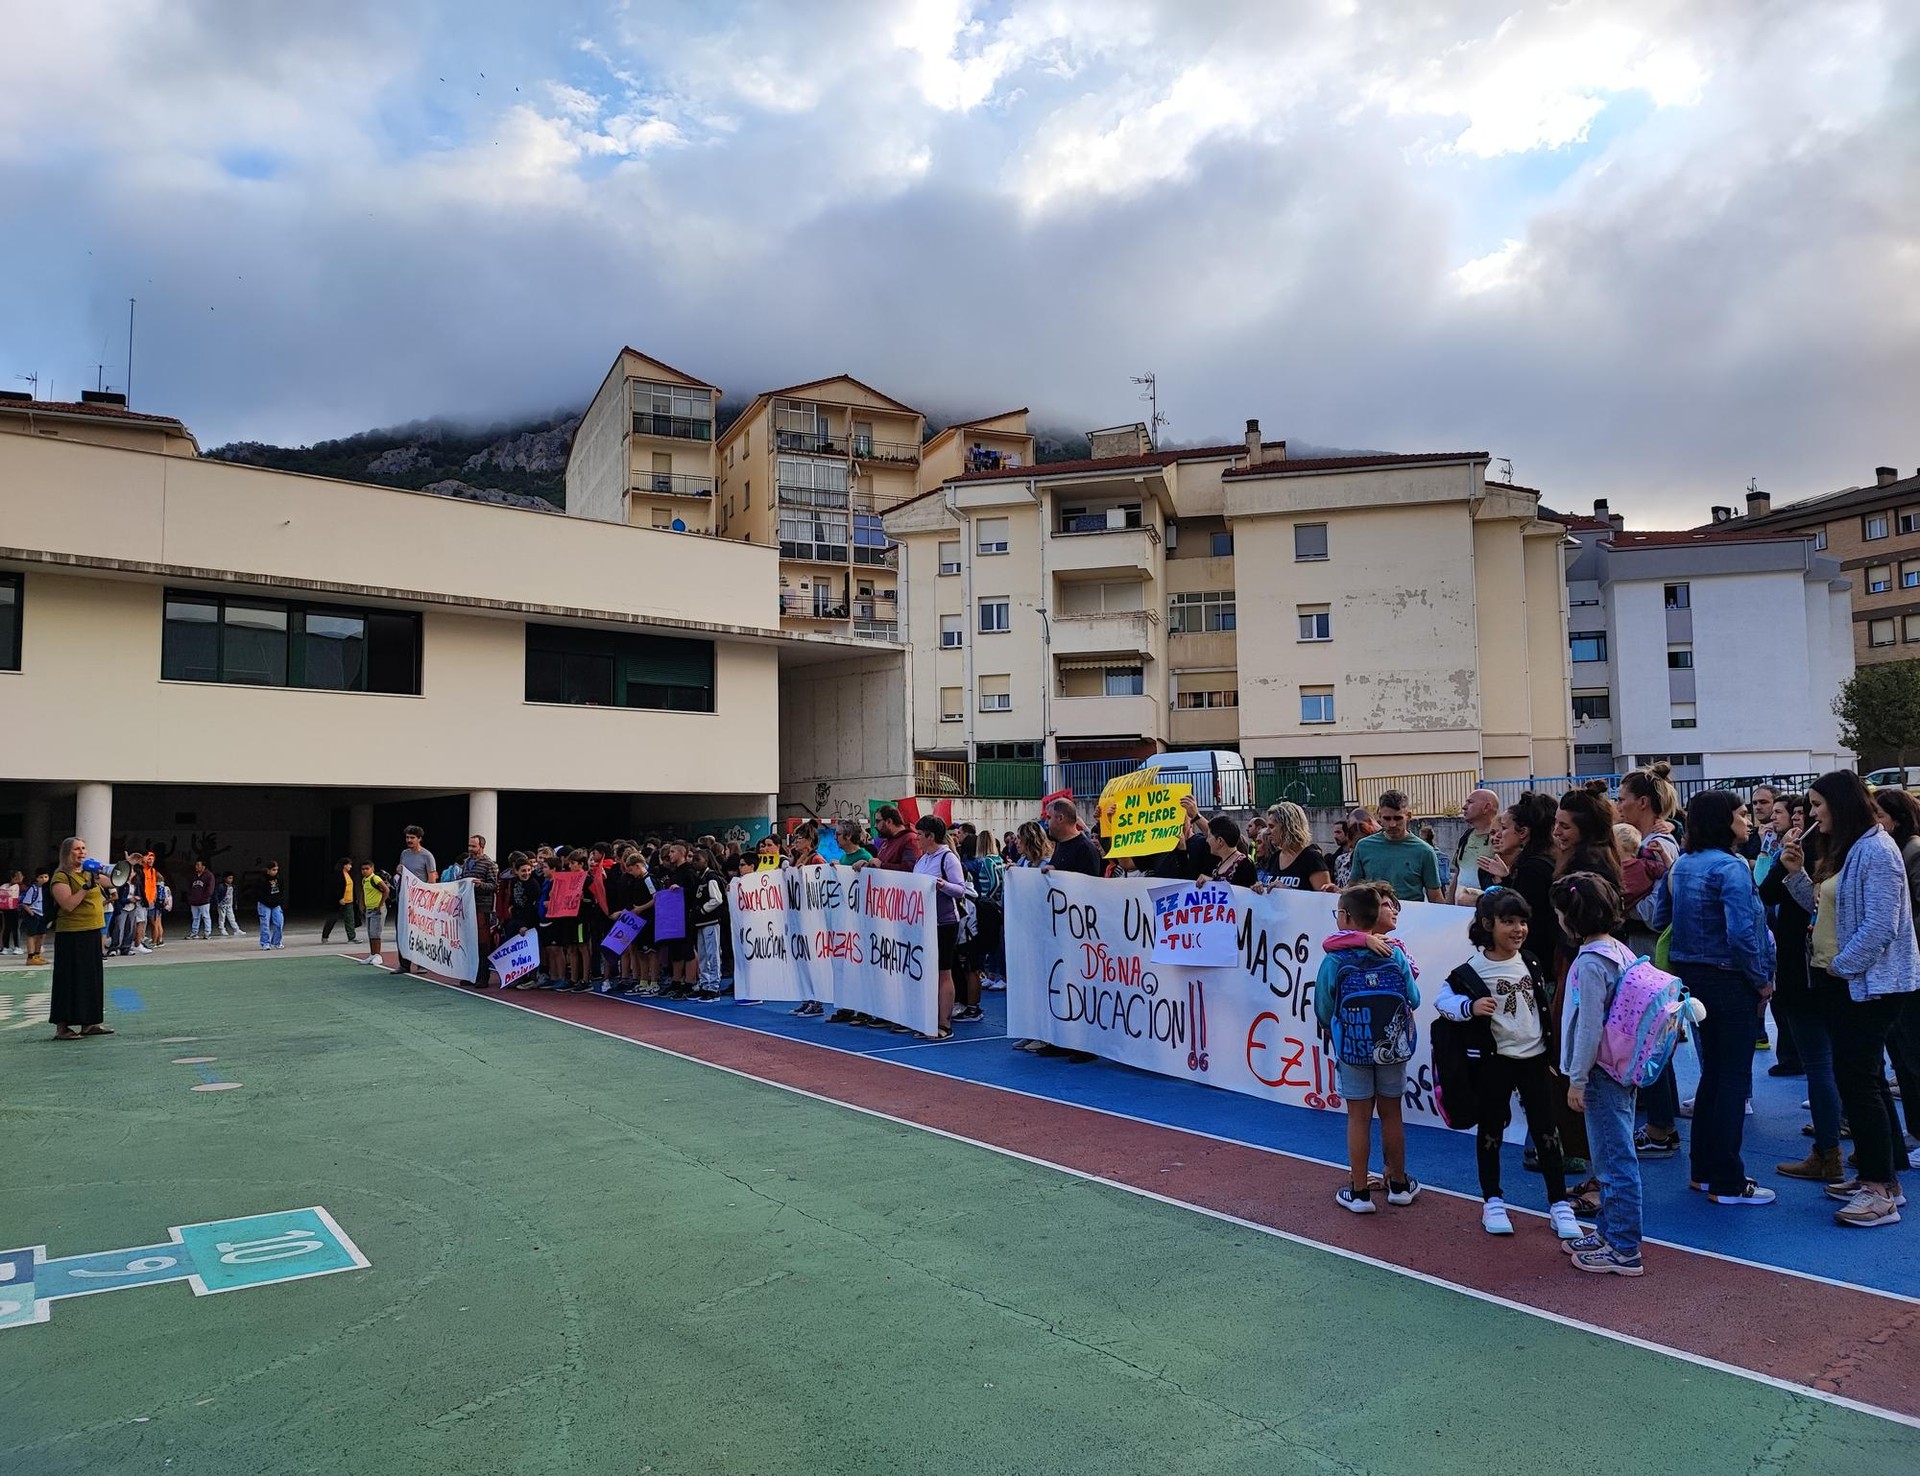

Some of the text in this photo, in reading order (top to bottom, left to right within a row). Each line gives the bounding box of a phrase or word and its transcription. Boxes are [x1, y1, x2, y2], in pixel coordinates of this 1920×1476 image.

[1125, 789, 1170, 809] MI VOZ
[1118, 806, 1177, 827] SE PIERDE
[1113, 829, 1148, 849] ENTRE
[787, 874, 801, 912] NO
[1156, 893, 1180, 916] EZ
[1047, 888, 1100, 941] POR
[1163, 904, 1236, 931] ENTERA
[791, 932, 811, 961] CON
[869, 932, 924, 981] BARATAS
